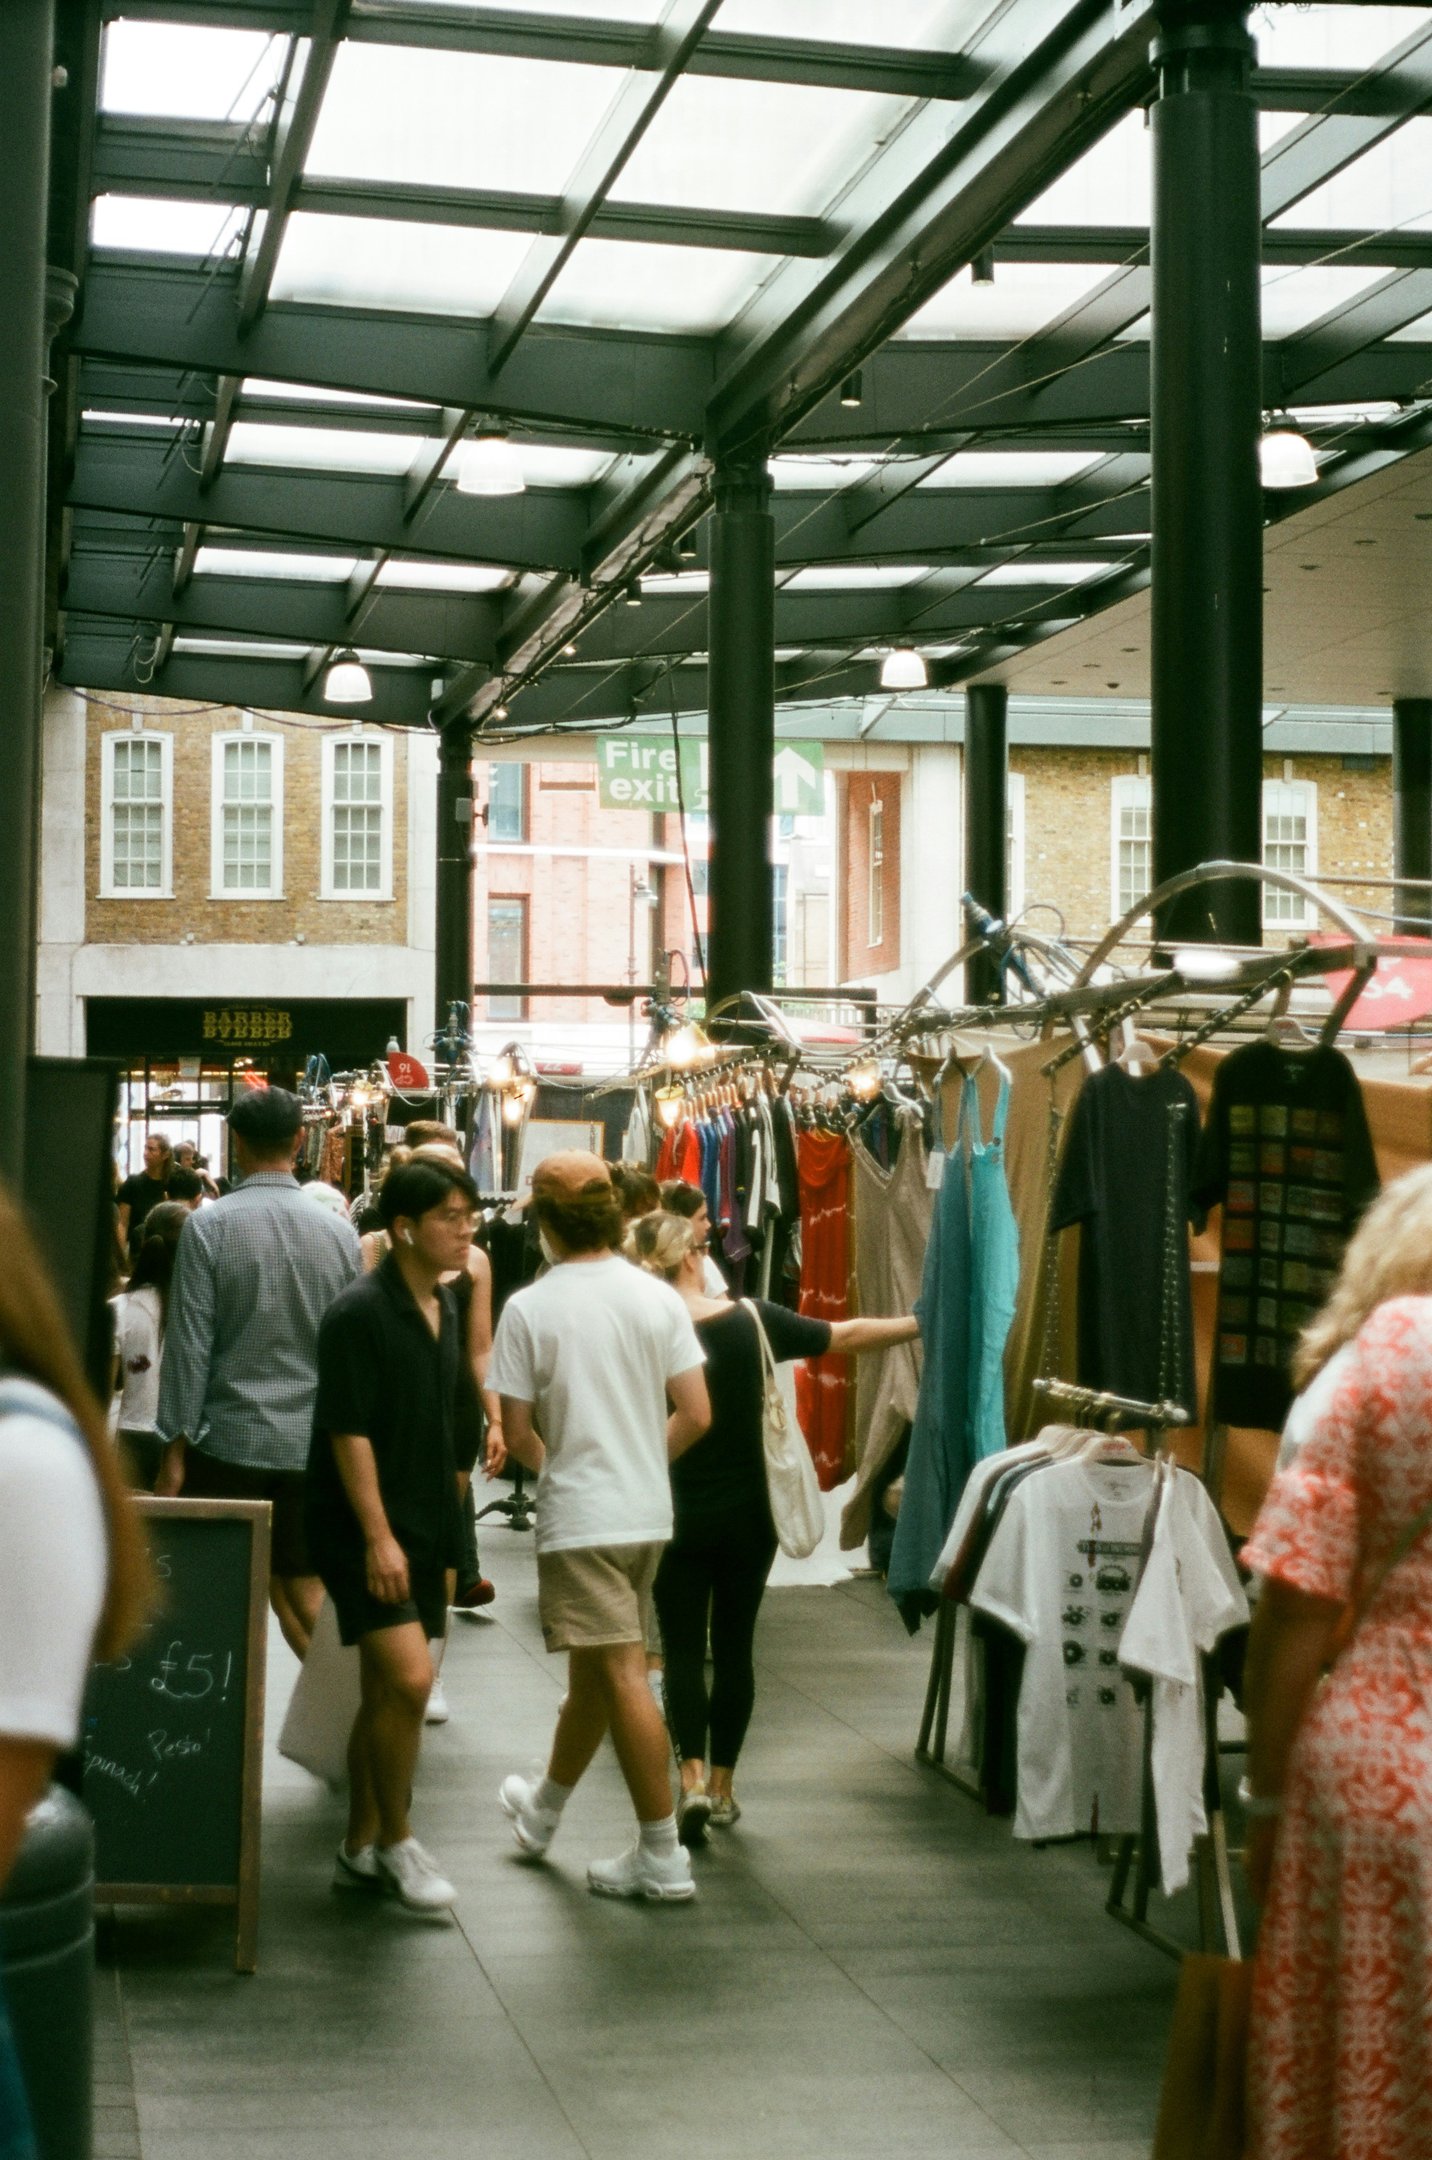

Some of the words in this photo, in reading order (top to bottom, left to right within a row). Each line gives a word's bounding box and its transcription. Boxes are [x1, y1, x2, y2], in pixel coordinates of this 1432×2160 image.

[605, 741, 677, 771] Fire
[609, 774, 679, 804] exit
[203, 1011, 290, 1025] BARBER
[151, 1641, 232, 1701] £5!
